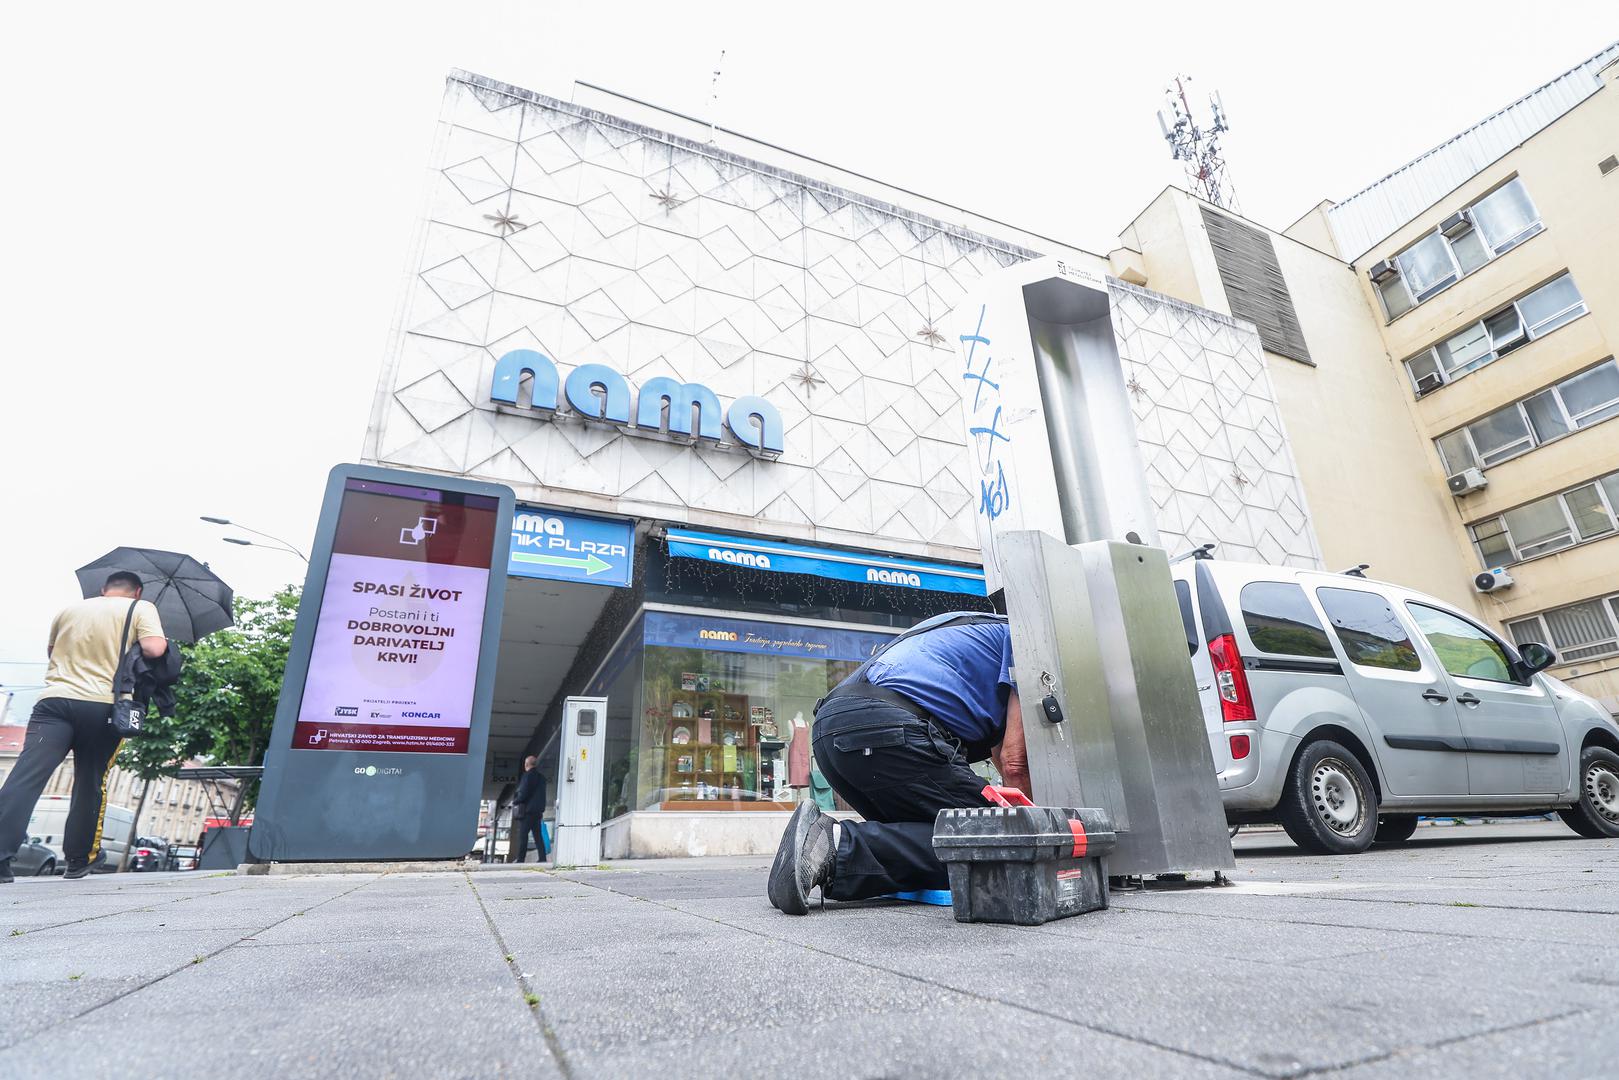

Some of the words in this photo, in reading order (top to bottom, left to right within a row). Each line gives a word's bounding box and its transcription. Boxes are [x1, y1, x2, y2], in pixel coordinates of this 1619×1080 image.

[490, 348, 784, 453] nama
[548, 537, 626, 557] PLAZA
[708, 548, 771, 569] nama
[866, 568, 921, 587] nama
[352, 581, 405, 597] SPASI
[409, 584, 463, 602] ŽIVOT
[369, 607, 420, 621] Postani
[423, 611, 428, 621] i
[430, 611, 440, 622] ti
[347, 620, 455, 637] DOBROVOLJNI
[700, 629, 739, 641] nama
[353, 635, 445, 651] DARIVATELJ
[377, 651, 418, 664] KRVI!
[129, 709, 140, 730] EA7
[339, 707, 358, 715] JYSK
